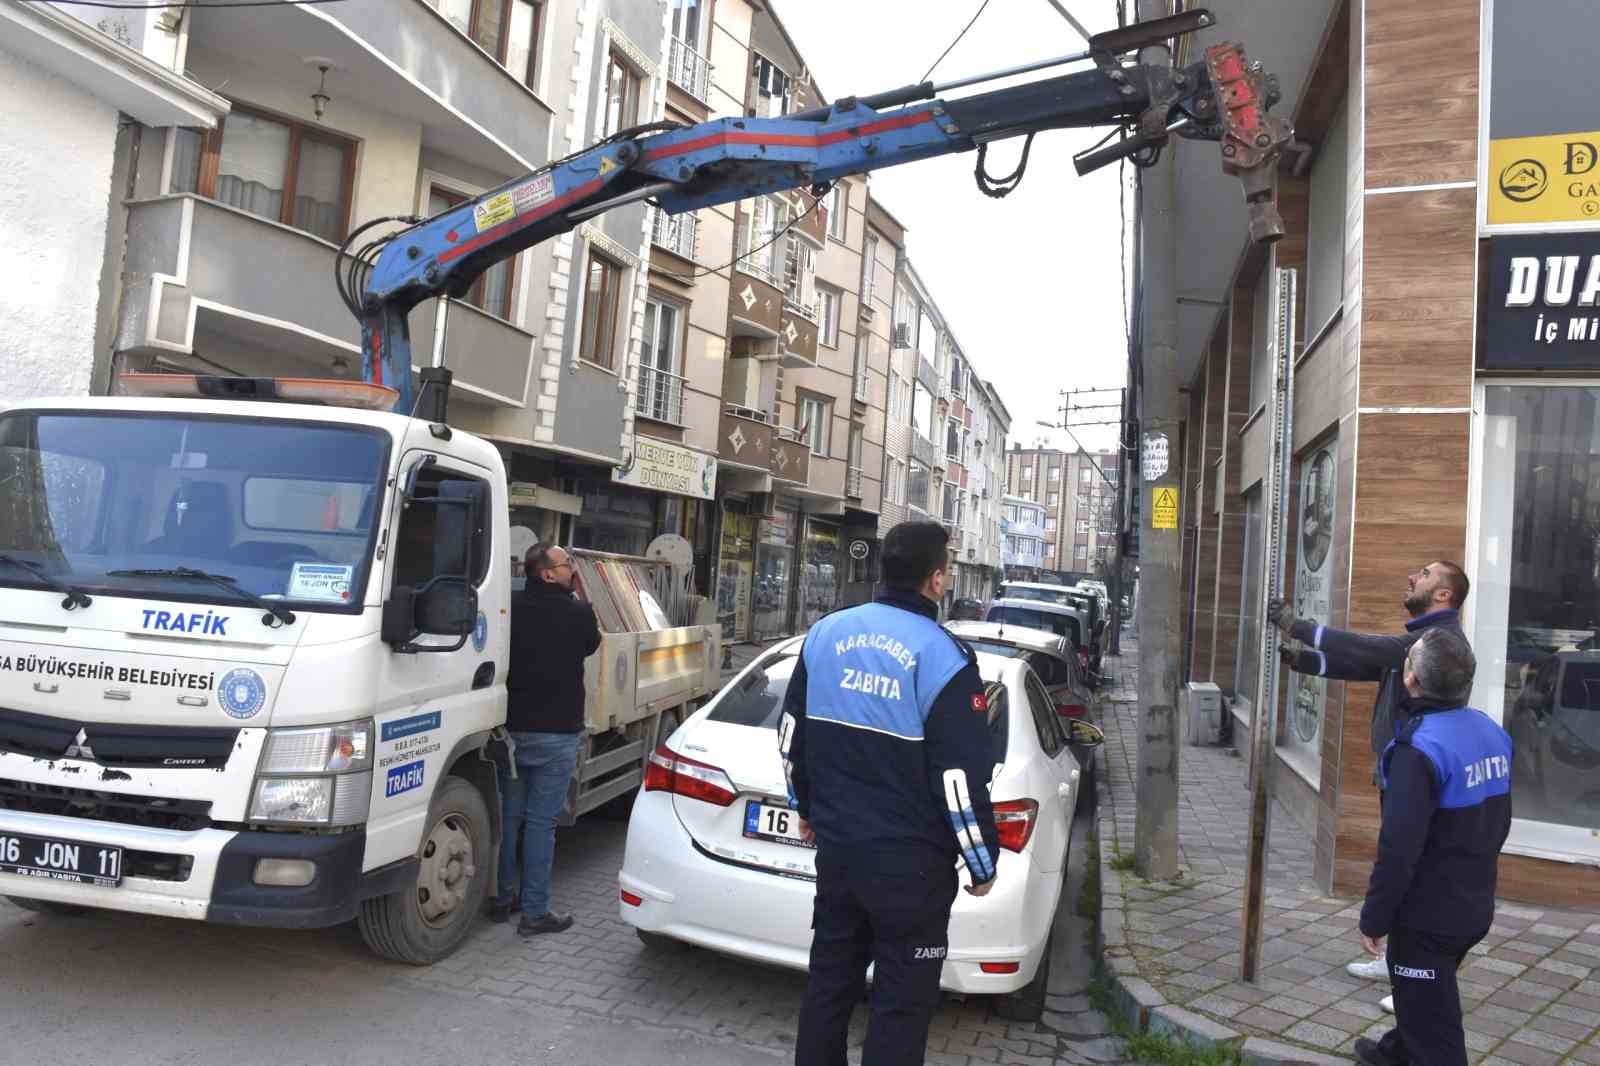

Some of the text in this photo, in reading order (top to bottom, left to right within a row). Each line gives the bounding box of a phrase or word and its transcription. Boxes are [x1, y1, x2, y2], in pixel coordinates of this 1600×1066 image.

[1568, 182, 1600, 198] GA
[1534, 314, 1600, 343] İç Mi
[640, 465, 690, 493] DÜNYASI
[142, 610, 230, 636] TRAFİK
[835, 633, 917, 671] KARACABEY
[16, 654, 114, 681] BÜYÜKŞEHİR
[118, 667, 214, 691] BELEDİYESİ
[840, 668, 901, 701] ZABITA
[388, 765, 423, 795] TRAFİK
[767, 810, 789, 834] 16
[0, 836, 118, 877] 16 JON 11
